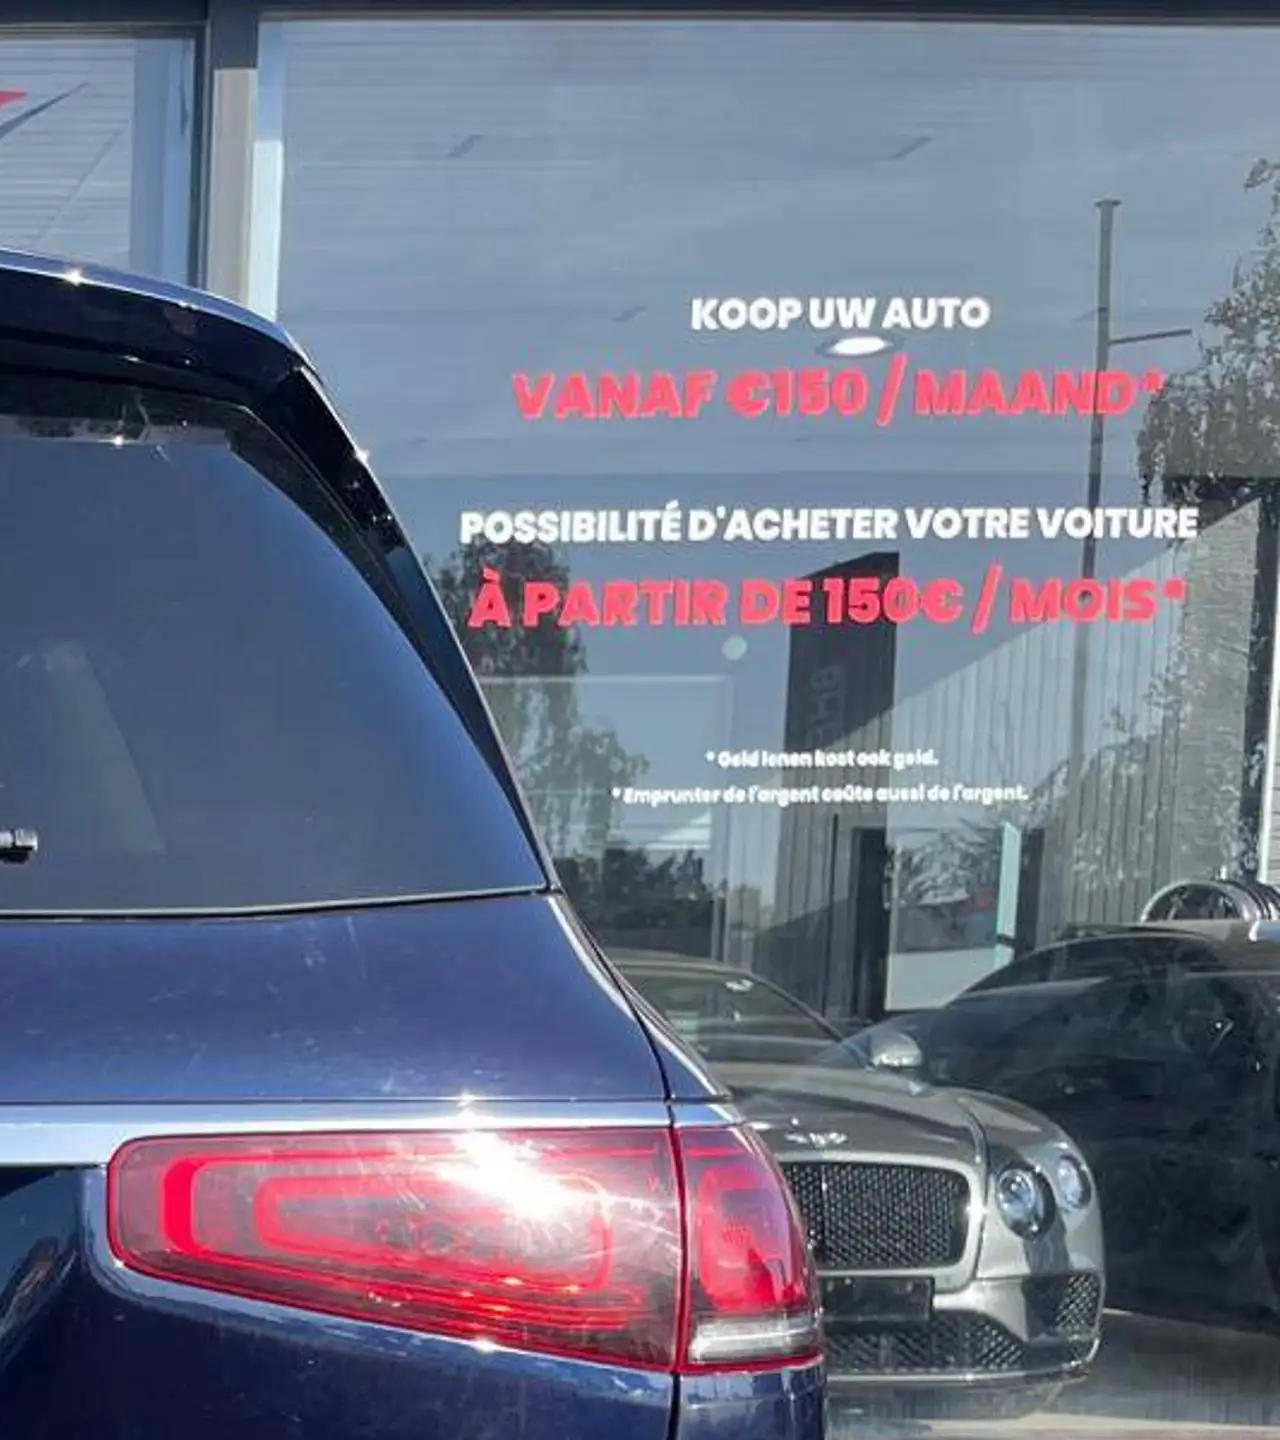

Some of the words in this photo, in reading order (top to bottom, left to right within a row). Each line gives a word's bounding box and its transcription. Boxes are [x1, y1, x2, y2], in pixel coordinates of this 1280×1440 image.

[691, 297, 802, 330] KOOP
[809, 297, 876, 329] UW
[882, 297, 990, 329] AUTO
[512, 368, 717, 419] VANAF
[460, 500, 682, 544] POSSIBILITÉ
[688, 505, 898, 542] D'ACHETER
[904, 508, 1030, 539] VOTRE
[1035, 508, 1199, 539] VOITURE
[468, 566, 512, 628] À
[522, 577, 728, 628] PARTIR
[740, 578, 813, 625] DE
[823, 576, 964, 624] 150€
